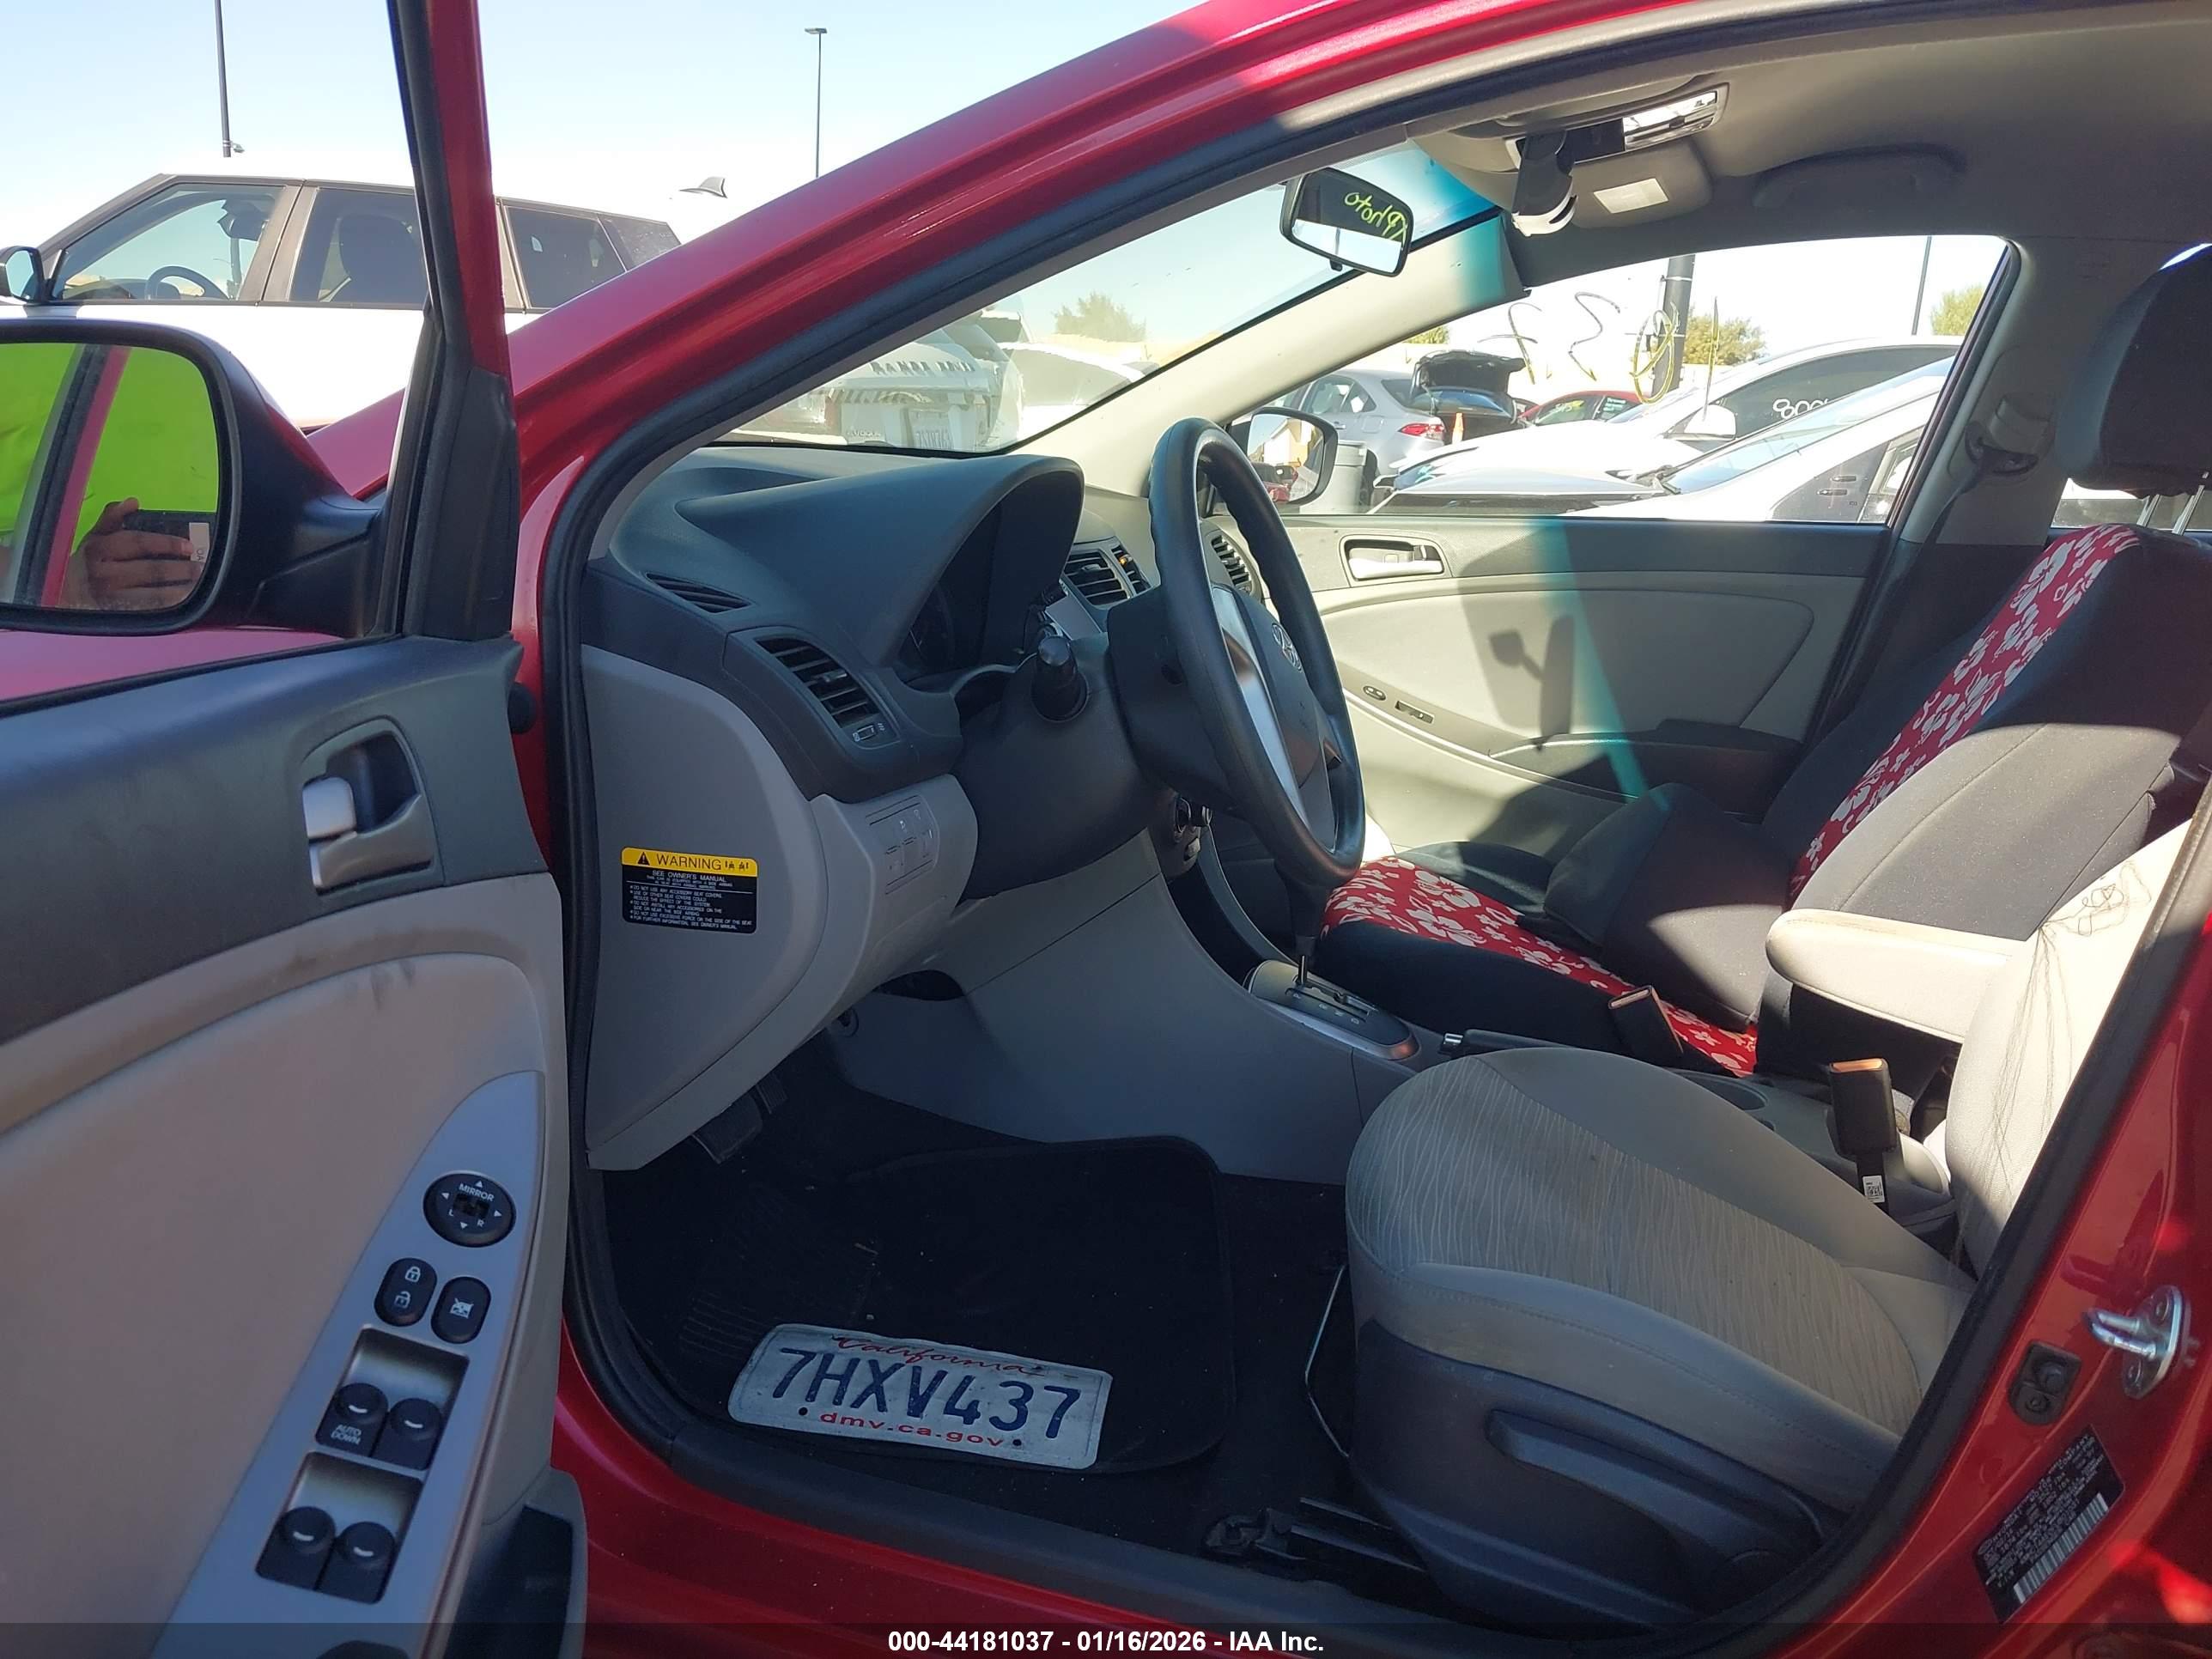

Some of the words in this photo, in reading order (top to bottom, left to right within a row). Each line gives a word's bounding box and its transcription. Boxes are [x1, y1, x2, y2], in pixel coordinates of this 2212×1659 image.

[656, 853, 721, 871] WARNING
[459, 1183, 495, 1201] MIRROR
[831, 1334, 1046, 1376] California
[773, 1347, 1081, 1438] 7HXV437
[331, 1431, 361, 1444] DOWN
[336, 1425, 362, 1436] AUTO
[819, 1412, 1004, 1447] dmv.ca.gov
